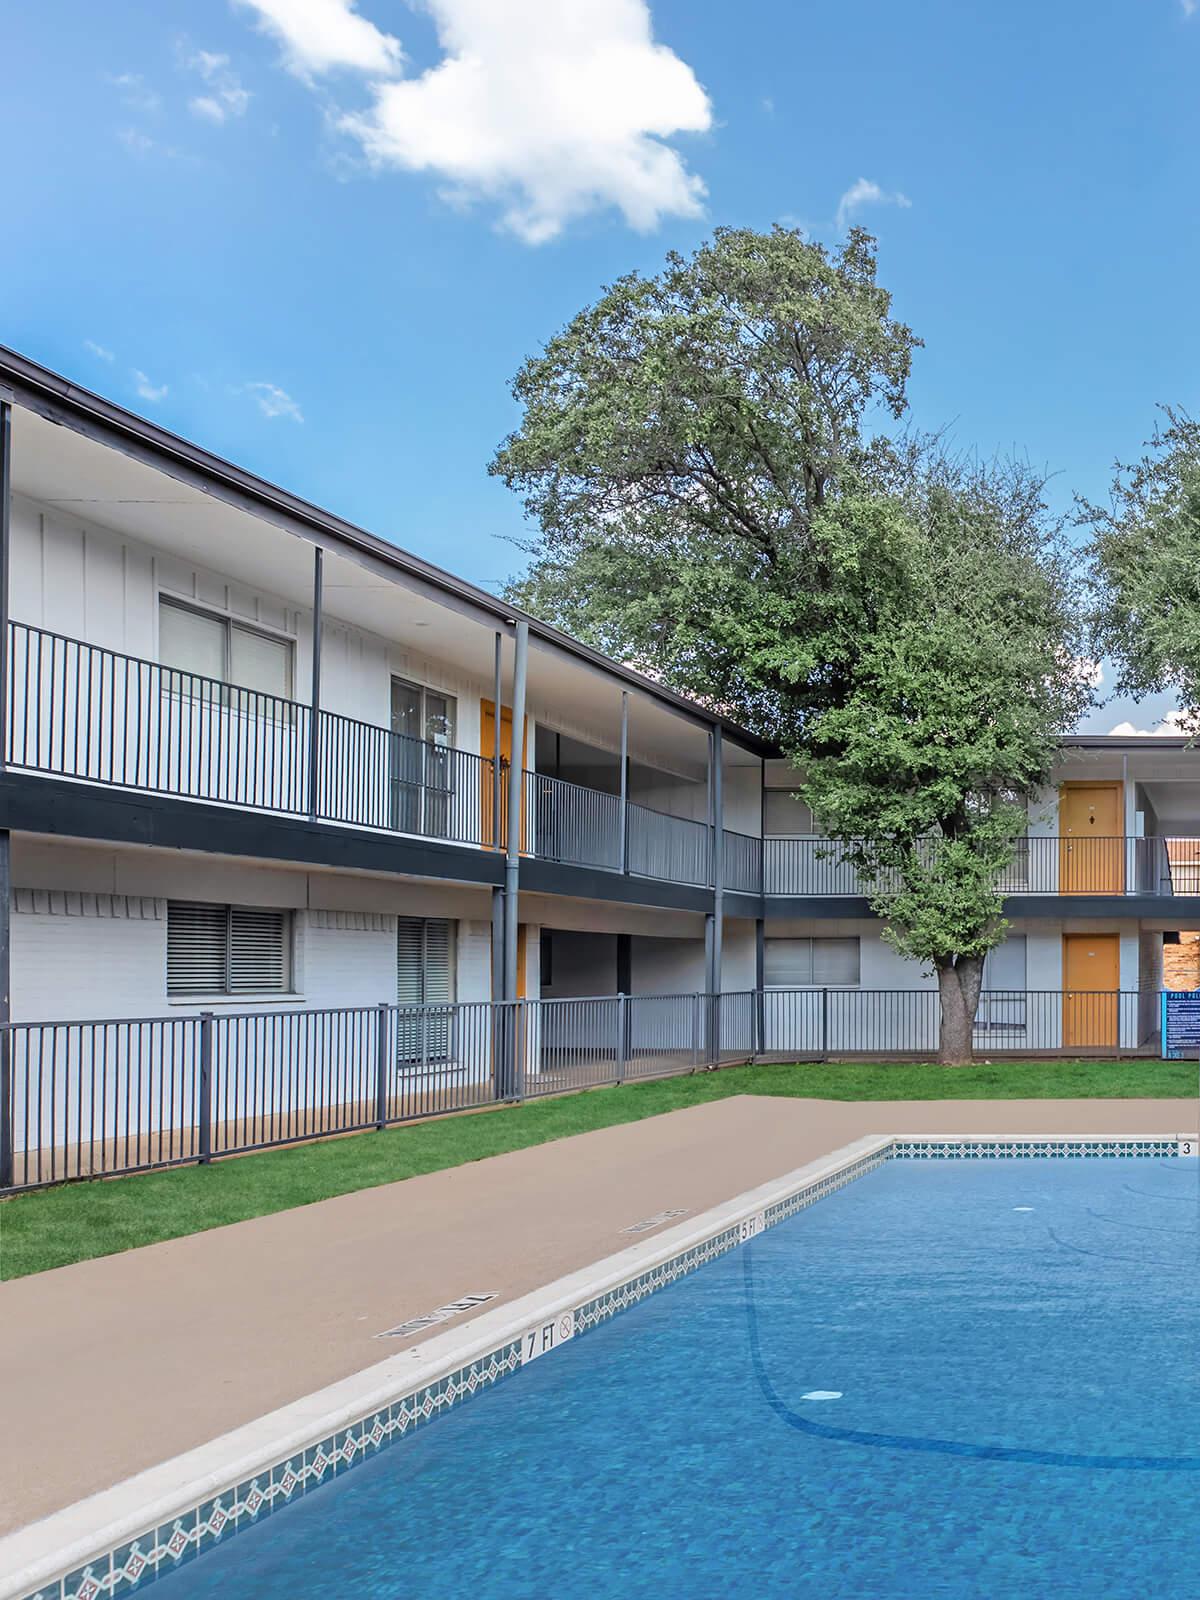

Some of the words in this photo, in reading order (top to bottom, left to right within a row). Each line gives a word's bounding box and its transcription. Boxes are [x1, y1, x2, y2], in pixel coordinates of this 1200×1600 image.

[1183, 1143, 1191, 1154] 3
[742, 1222, 747, 1239] 5
[527, 1331, 537, 1359] 7
[542, 1322, 556, 1352] FT
